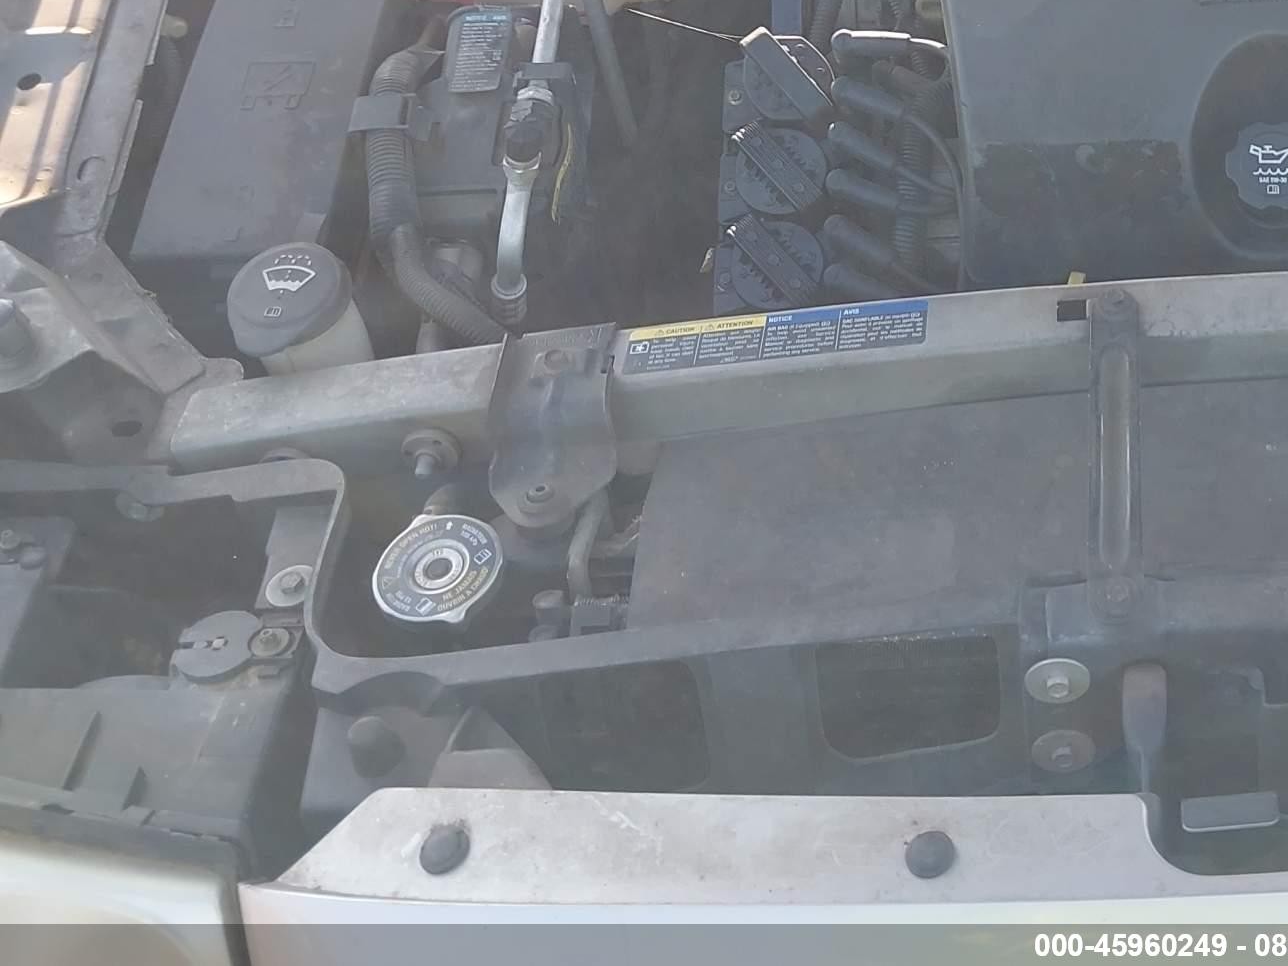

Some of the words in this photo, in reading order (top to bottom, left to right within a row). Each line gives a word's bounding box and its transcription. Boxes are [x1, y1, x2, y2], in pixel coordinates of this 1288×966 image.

[768, 315, 793, 323] NOTICE
[716, 320, 754, 329] ATTENTION
[666, 326, 696, 334] CAUTION
